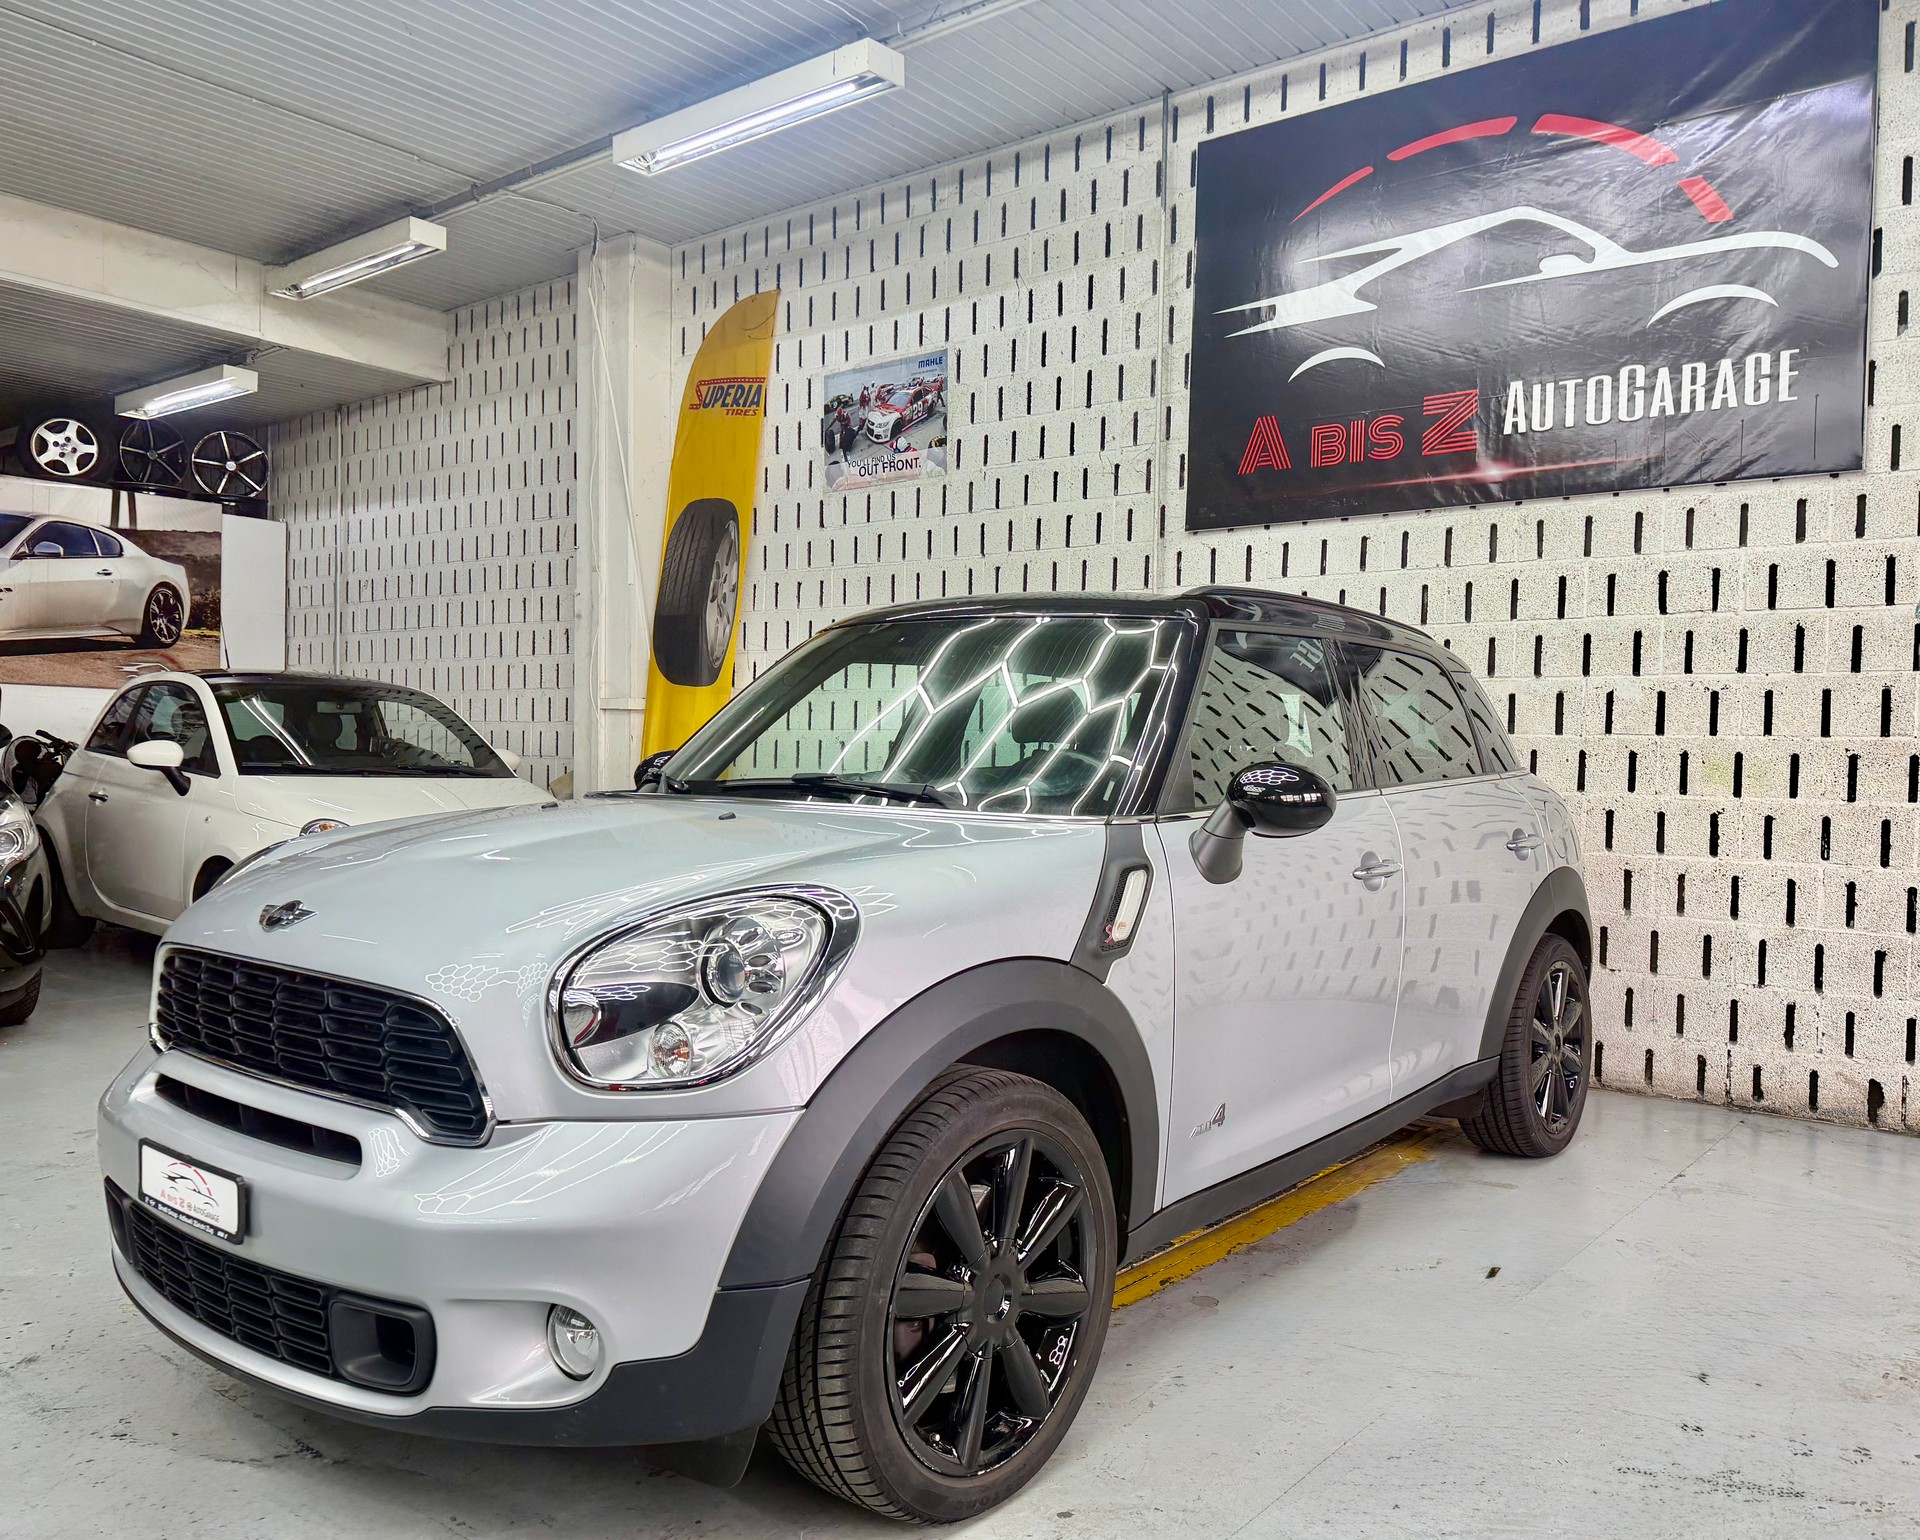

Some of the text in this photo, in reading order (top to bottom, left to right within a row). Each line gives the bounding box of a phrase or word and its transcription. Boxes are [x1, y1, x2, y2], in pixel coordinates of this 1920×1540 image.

[918, 356, 943, 369] MAHLE
[689, 377, 766, 410] SUPERIA
[725, 408, 758, 417] TIRES
[913, 401, 923, 420] 29
[1237, 415, 1292, 475] A
[1311, 414, 1405, 469] BIS
[1421, 389, 1479, 456] Z
[847, 454, 896, 468] YOU'LL FIND US
[859, 457, 922, 477] OUT FRONT.
[160, 1189, 166, 1199] A
